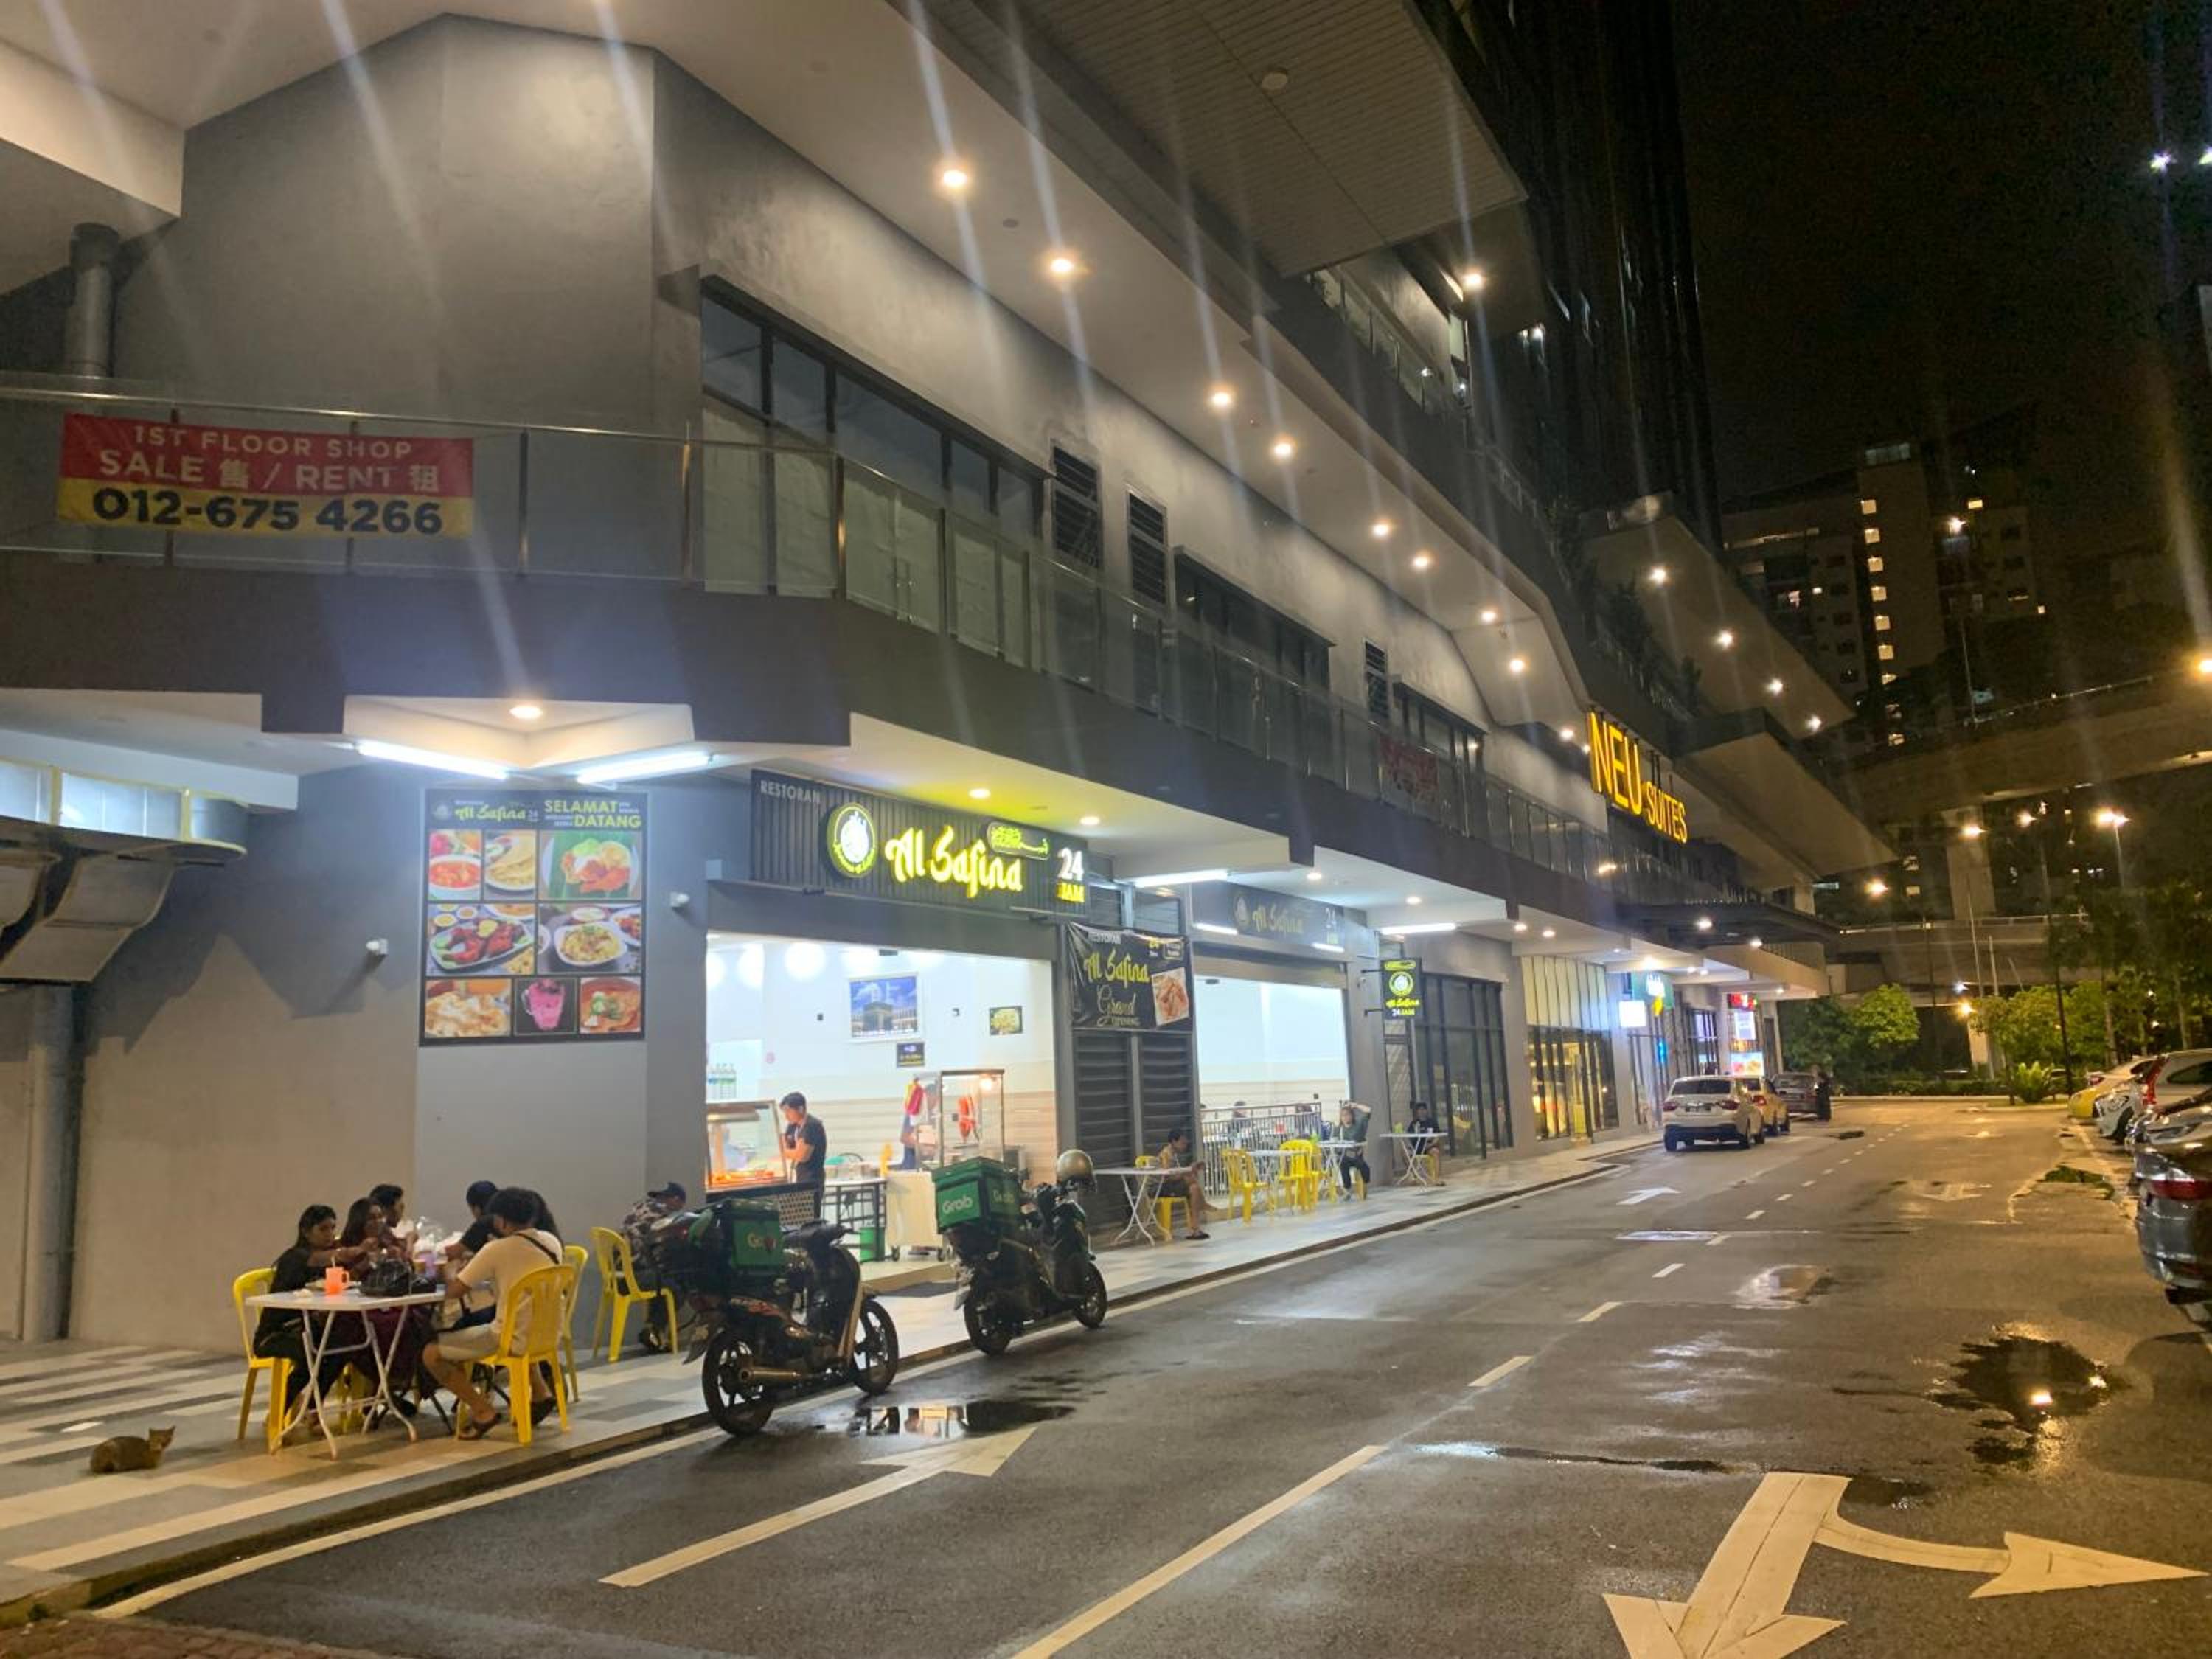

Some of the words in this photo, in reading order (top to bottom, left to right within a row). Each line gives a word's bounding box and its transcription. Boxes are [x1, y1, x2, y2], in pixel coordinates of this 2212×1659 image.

[134, 425, 187, 447] 1ST
[201, 431, 311, 458] FLOOR
[327, 438, 412, 460] SHOP
[99, 448, 205, 483] SALE
[262, 462, 282, 490] /
[296, 463, 400, 492] RENT
[409, 464, 439, 493] 租
[93, 487, 299, 531] 012-675
[315, 498, 442, 535] 4266
[760, 779, 821, 804] RESTORAN
[1587, 711, 1643, 815] NEU
[1644, 781, 1688, 844] SUITES
[544, 799, 618, 813] SELAMAT
[574, 814, 641, 827] DATANG
[885, 827, 926, 883] Al
[930, 824, 1023, 899] Safina
[1057, 846, 1084, 882] 24
[1105, 947, 1151, 989] Safina
[942, 1194, 972, 1214] Grab
